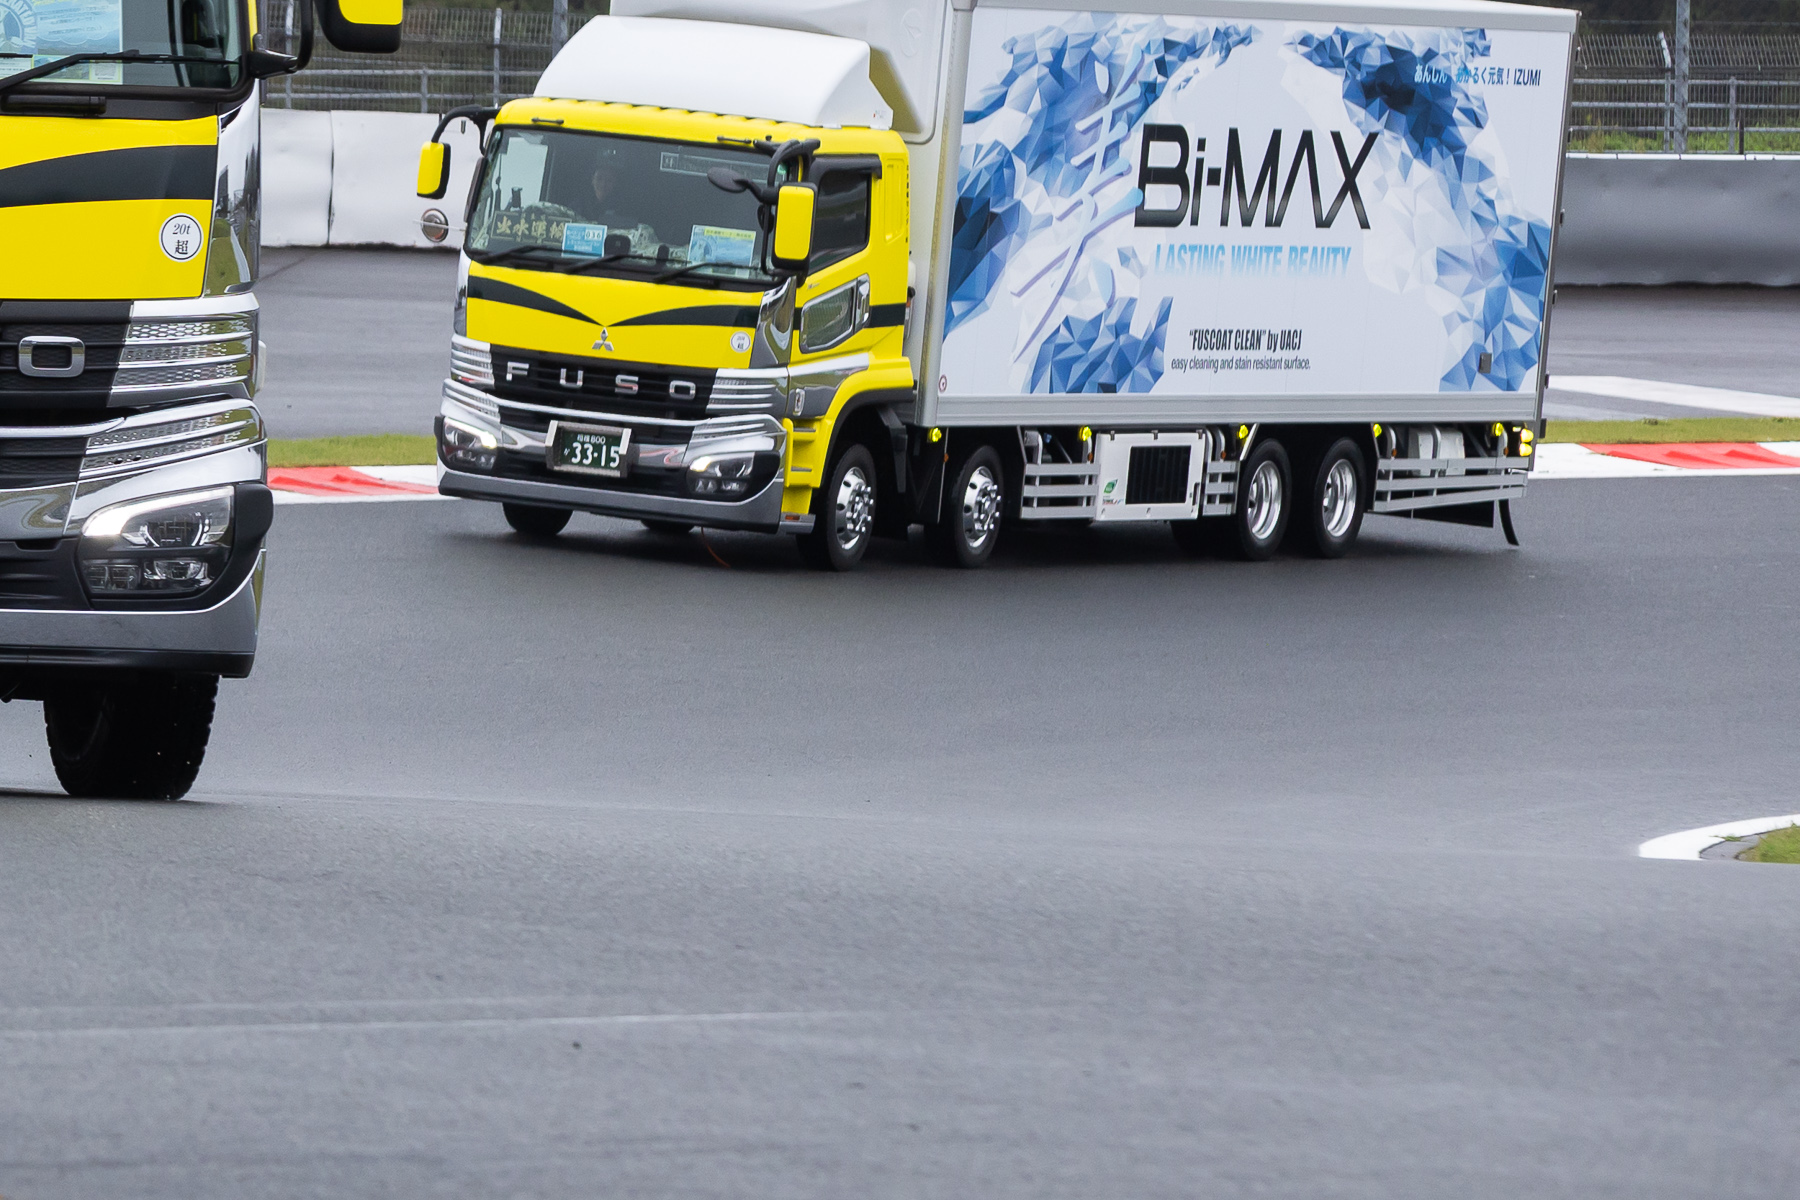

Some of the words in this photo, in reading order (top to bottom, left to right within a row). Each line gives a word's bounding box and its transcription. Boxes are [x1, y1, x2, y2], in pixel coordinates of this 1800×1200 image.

[1513, 68, 1541, 86] IZUMI
[172, 223, 191, 235] 20t
[174, 239, 189, 255] 超
[1154, 243, 1226, 278] LASTING
[1230, 244, 1283, 278] WHITE
[1288, 246, 1352, 278] BEAUTY
[1266, 329, 1279, 353] by
[1279, 329, 1302, 351] UACJ
[1171, 358, 1189, 373] easy
[1189, 356, 1219, 373] cleaning
[1219, 356, 1234, 370] and
[1234, 356, 1252, 370] stain
[1252, 355, 1282, 370] resistant
[506, 361, 696, 400] FUSO
[571, 441, 620, 468] 33-15
